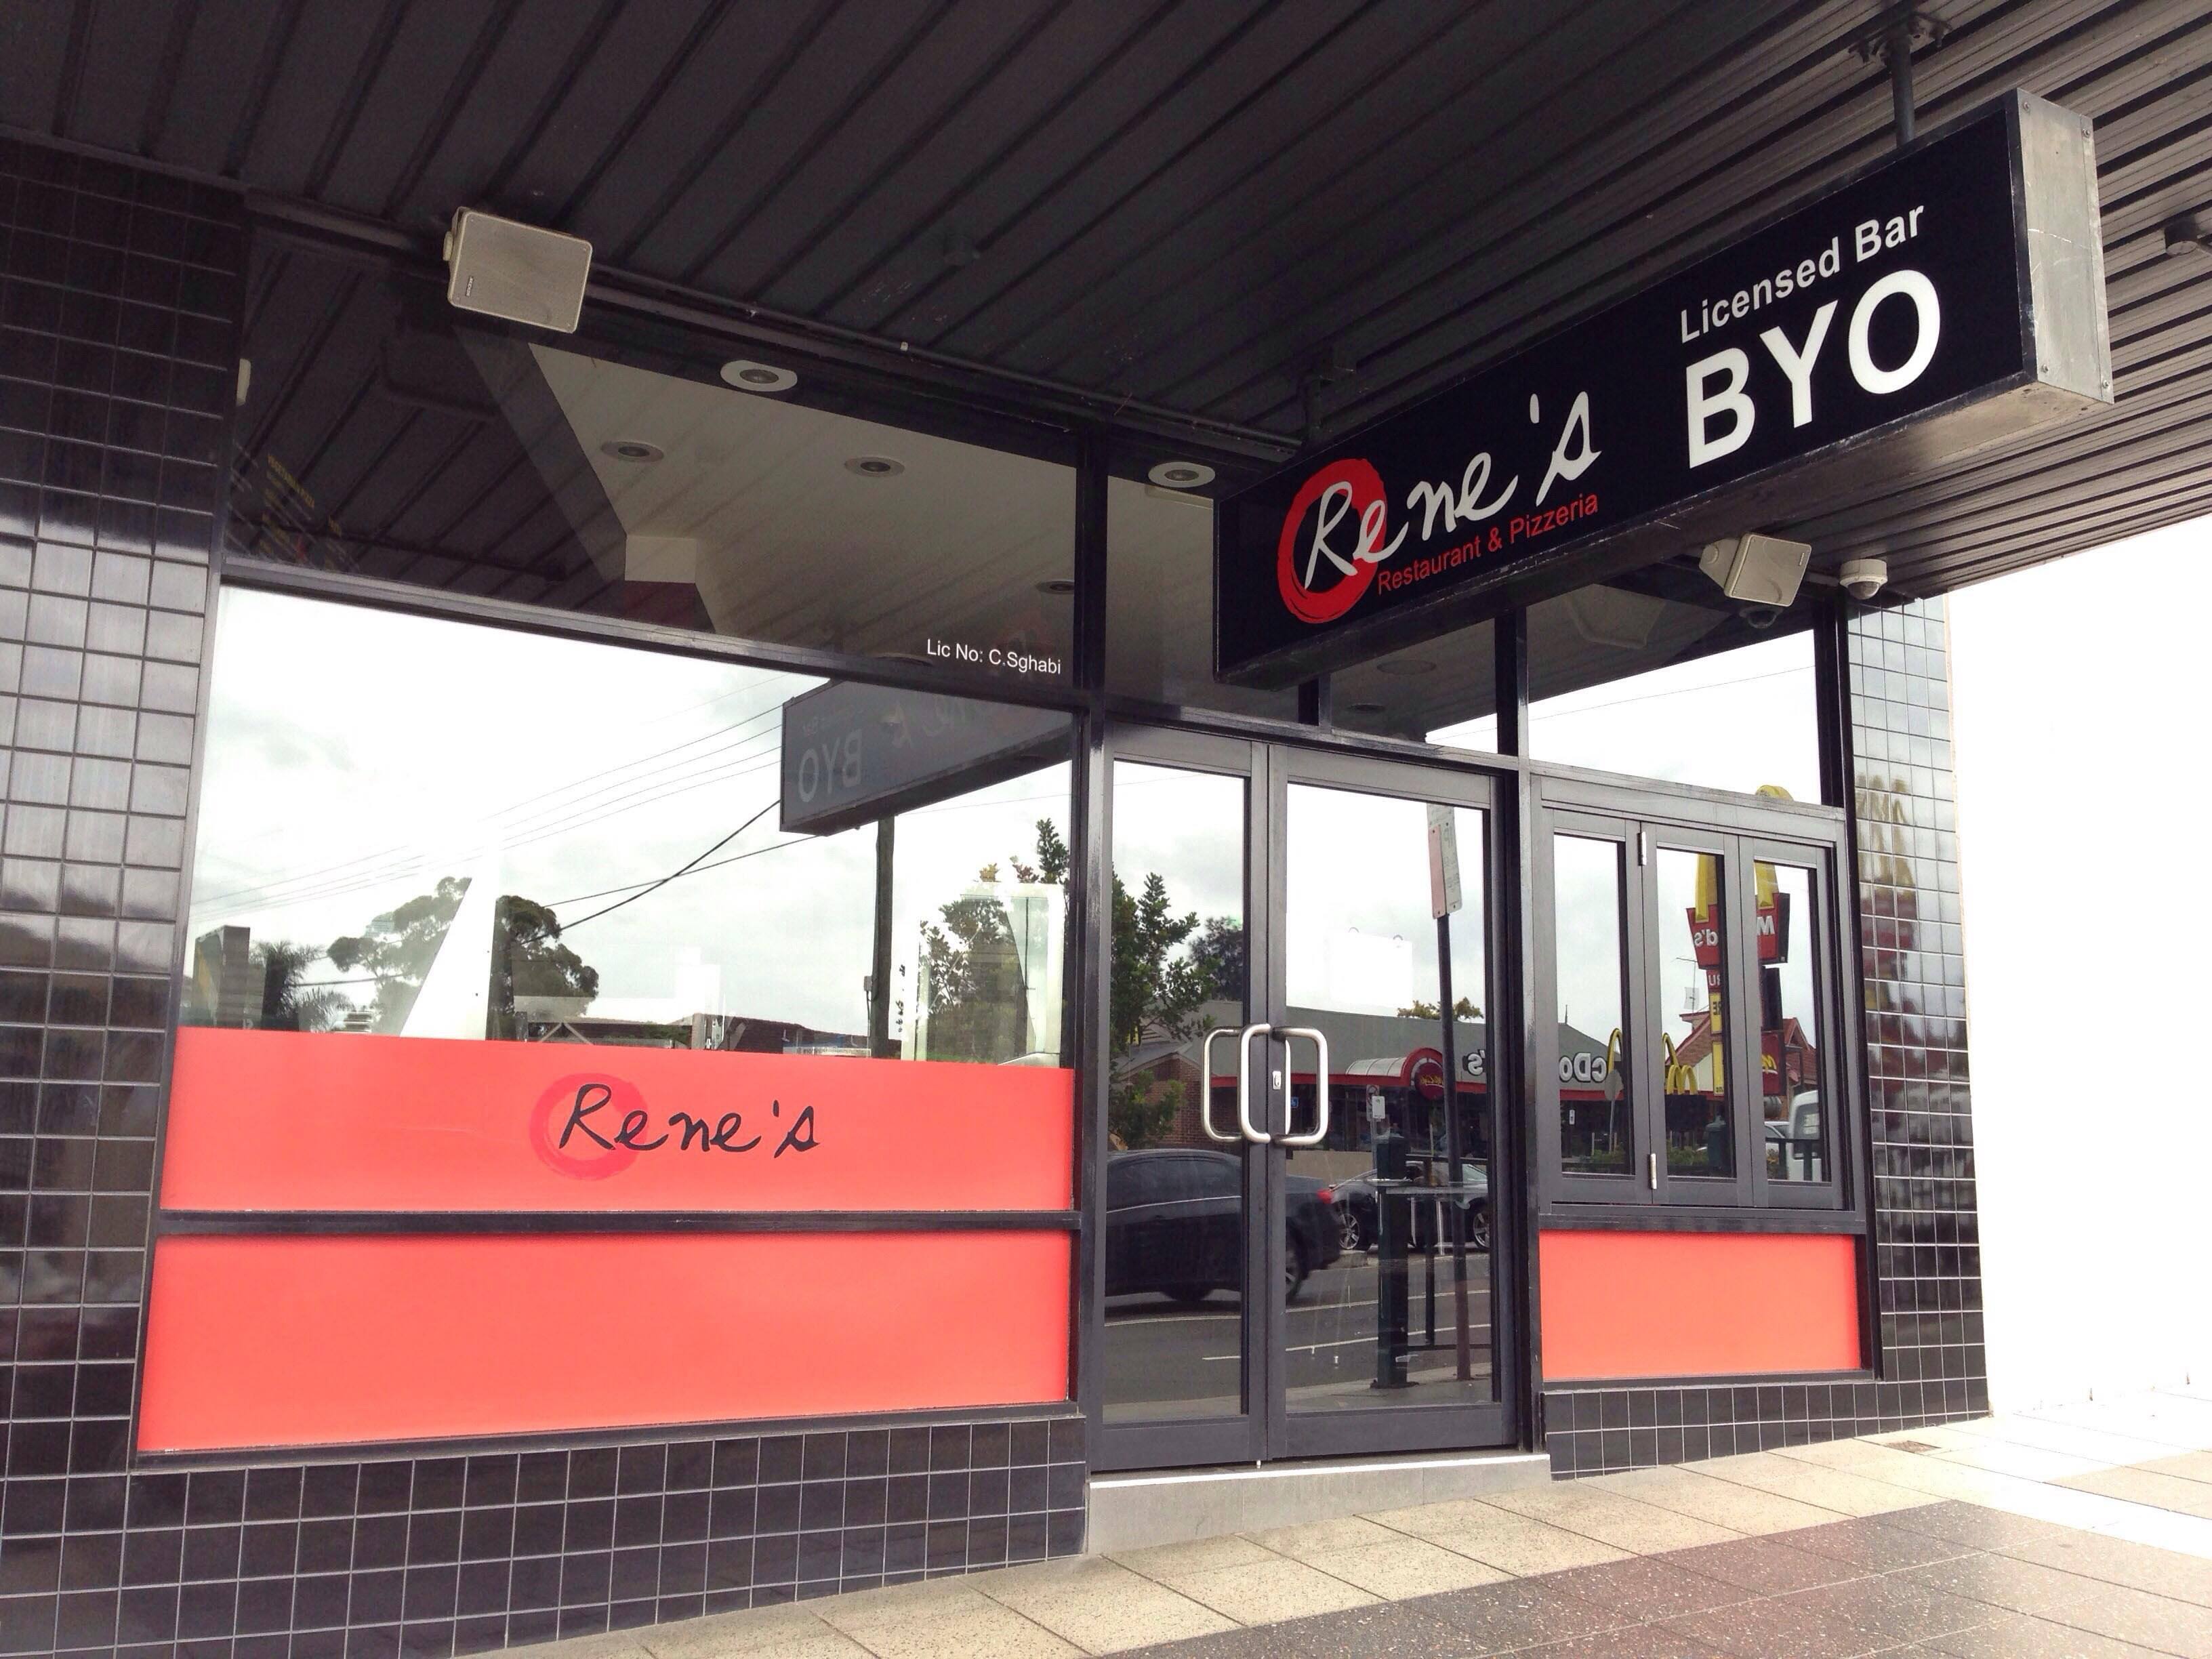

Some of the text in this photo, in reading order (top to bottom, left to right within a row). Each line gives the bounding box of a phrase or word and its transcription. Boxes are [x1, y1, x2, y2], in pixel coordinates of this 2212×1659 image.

[1681, 205, 1925, 344] Licensed Bar
[1685, 269, 1941, 470] BYO
[1304, 390, 1602, 590] Rene's
[1378, 491, 1599, 596] Restaurant & Pizzeria
[927, 638, 1061, 675] Lic No: C.Sghabi
[558, 1083, 821, 1158] Rene's
